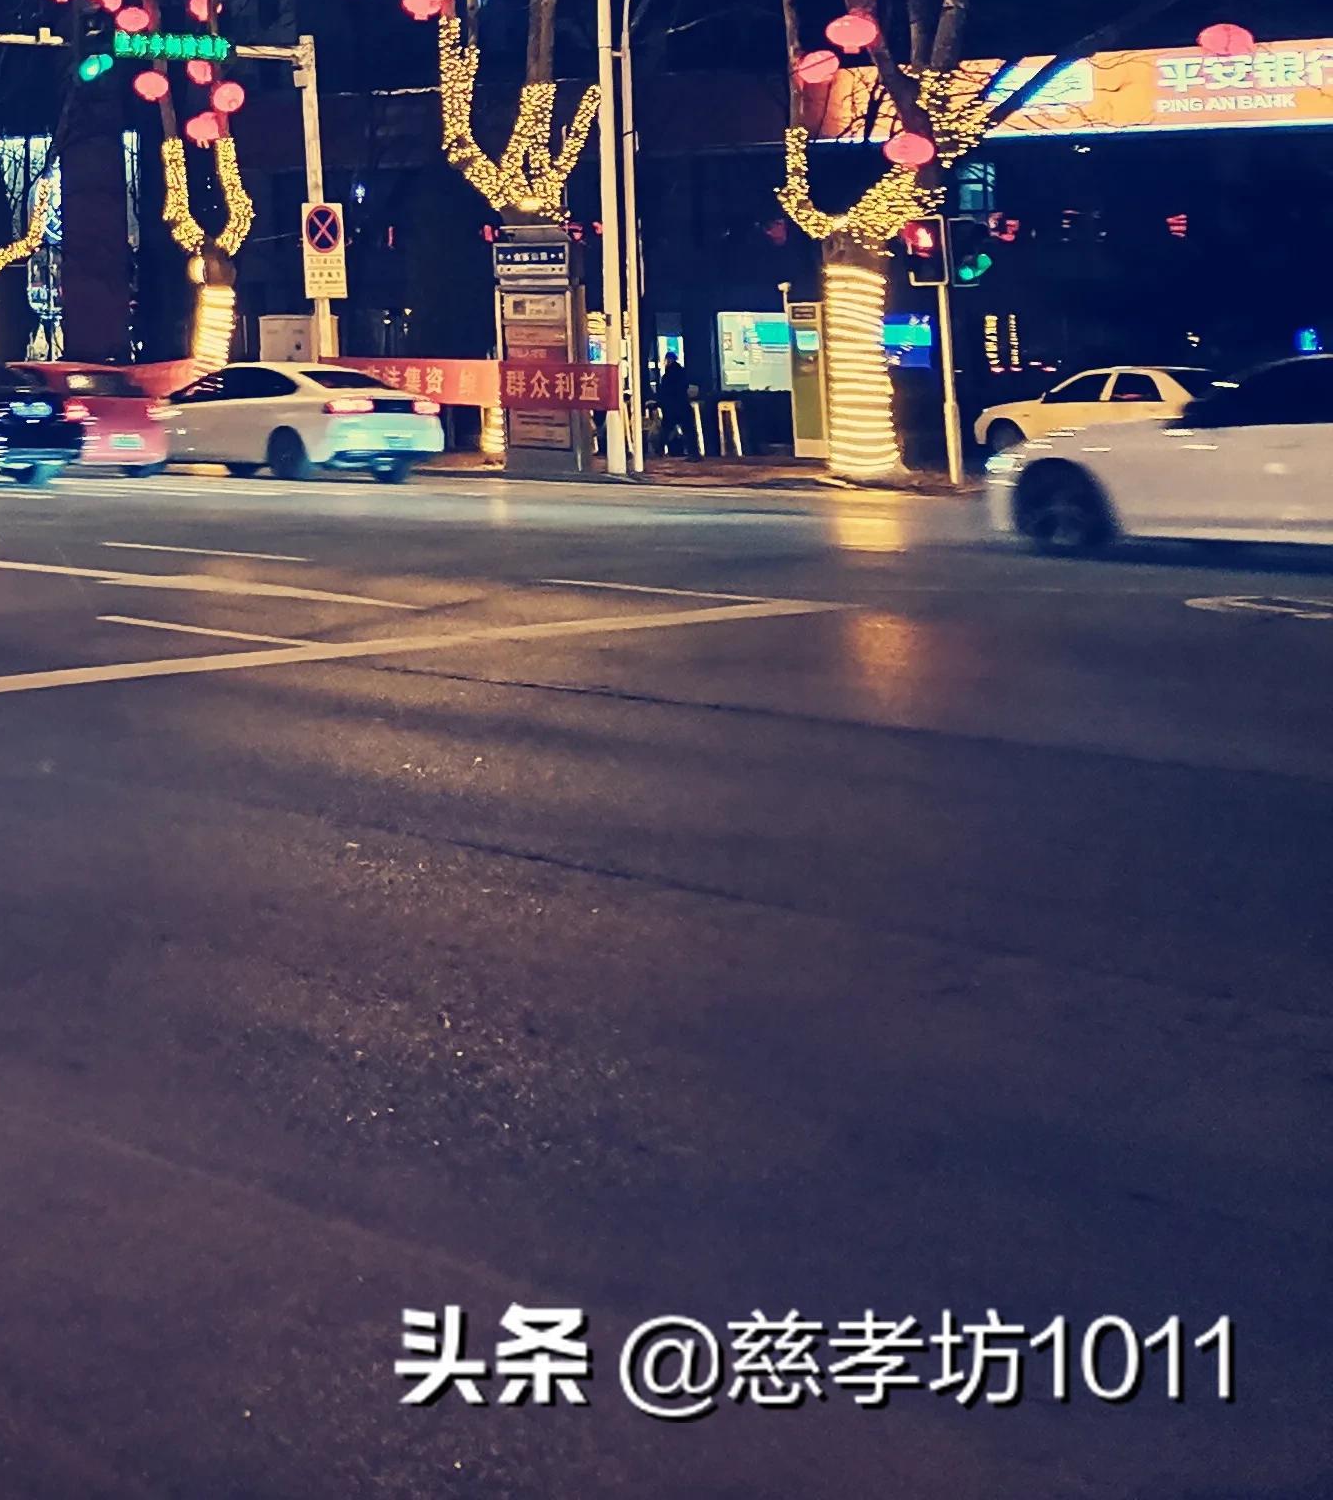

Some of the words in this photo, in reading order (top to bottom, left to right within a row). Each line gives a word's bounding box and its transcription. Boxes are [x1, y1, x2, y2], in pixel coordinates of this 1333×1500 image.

[1157, 98, 1203, 113] PING
[1206, 97, 1236, 111] AN
[1237, 93, 1296, 110] BANK
[506, 369, 601, 402] 群众利益
